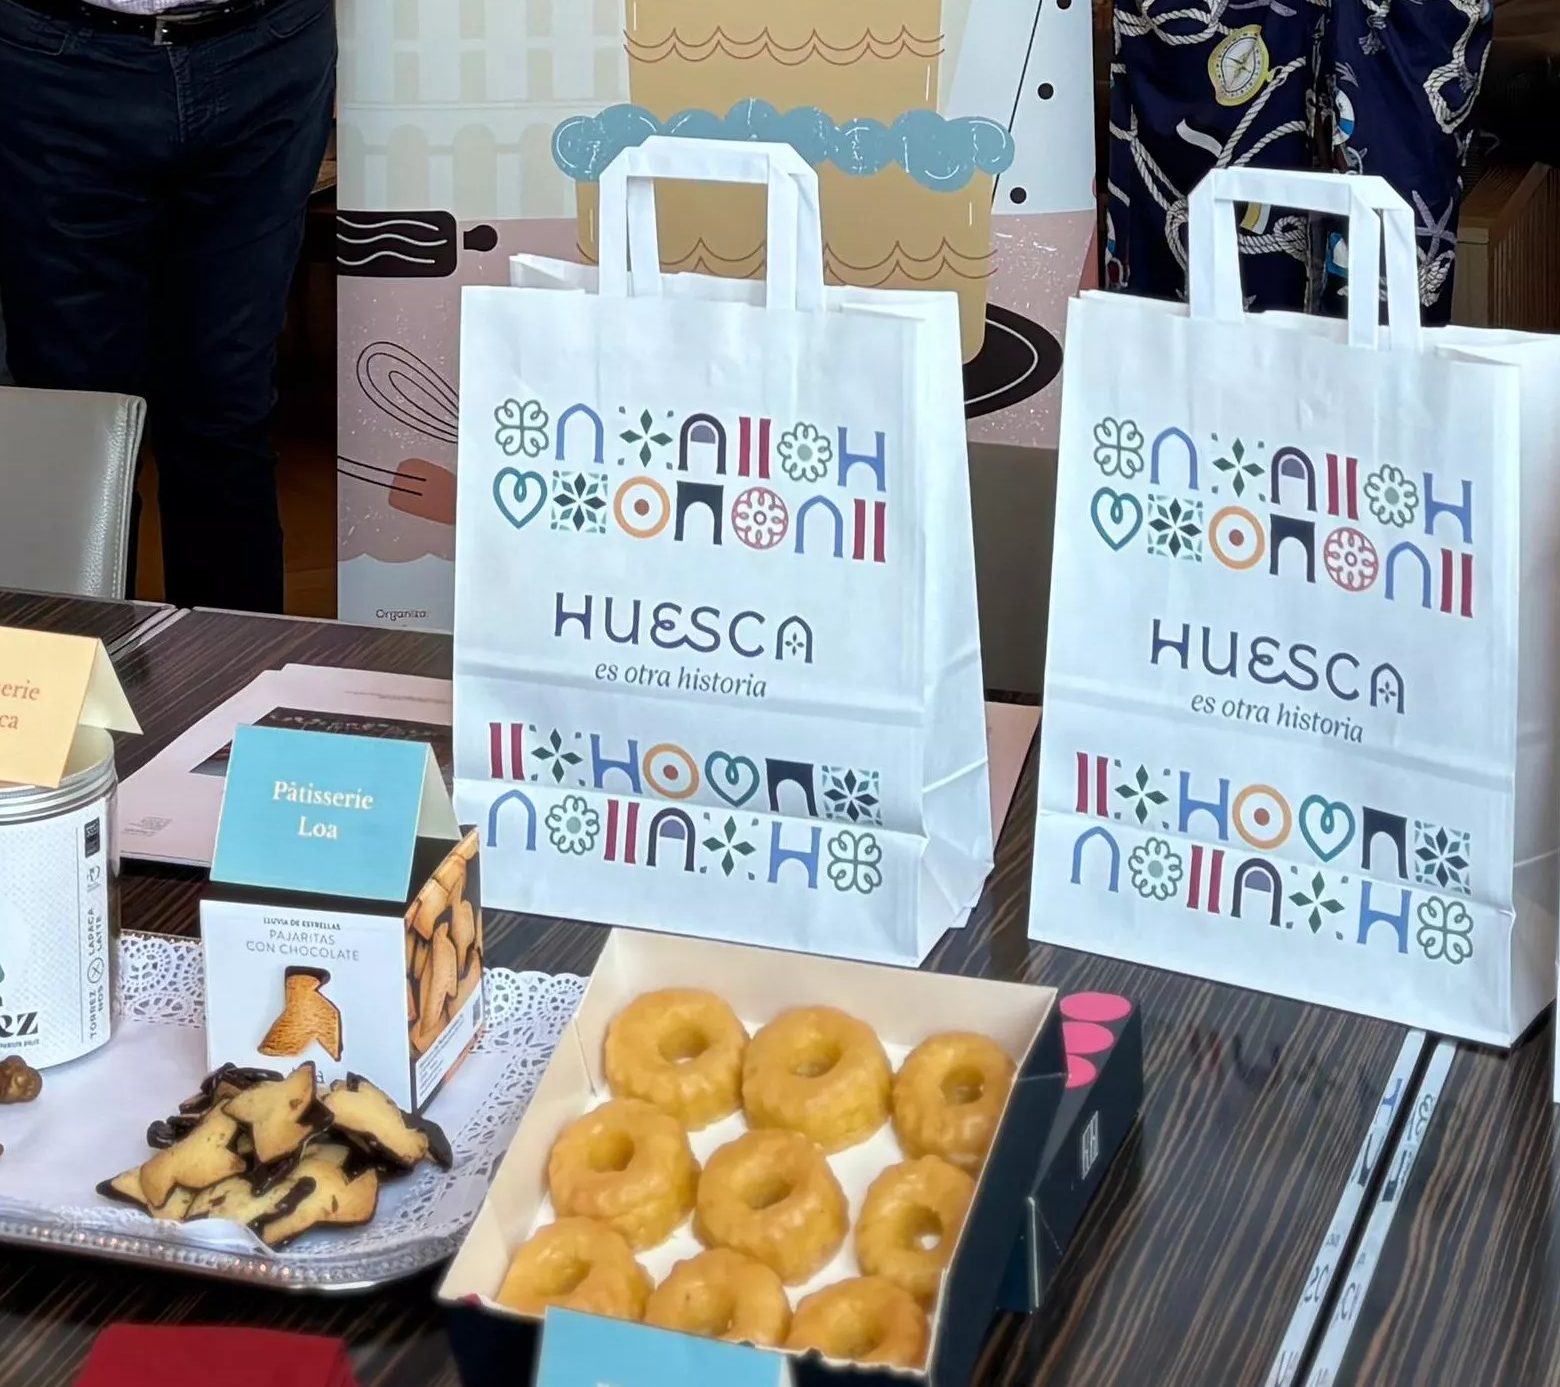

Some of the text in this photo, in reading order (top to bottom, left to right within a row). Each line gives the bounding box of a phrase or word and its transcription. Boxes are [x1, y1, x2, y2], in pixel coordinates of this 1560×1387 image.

[554, 592, 814, 664] HUESCA
[594, 663, 767, 698] es otra historia
[1150, 618, 1405, 715] HUESCA
[1191, 694, 1364, 744] es otra historia
[271, 779, 375, 810] Pâtisserie
[297, 815, 338, 840] Loa
[246, 940, 360, 962] CON CHOCOLATE
[269, 929, 336, 946] PAJARITAS
